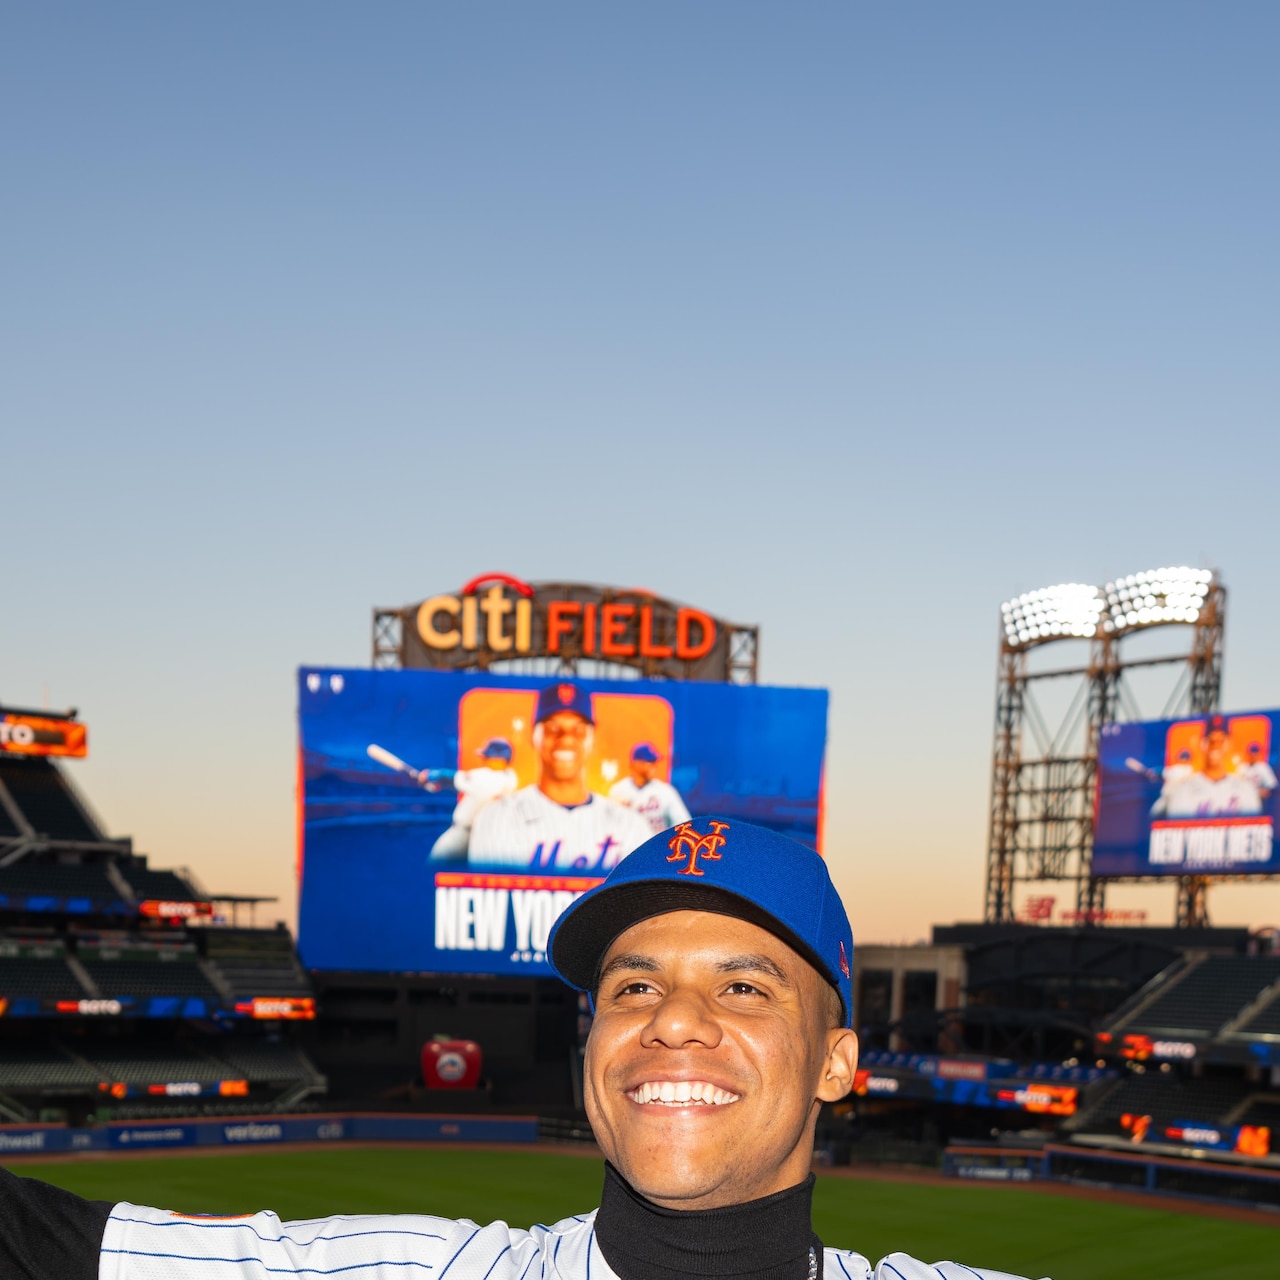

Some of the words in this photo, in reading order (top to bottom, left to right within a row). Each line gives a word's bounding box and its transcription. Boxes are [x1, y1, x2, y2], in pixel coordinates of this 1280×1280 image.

[548, 602, 716, 660] FIELD
[435, 888, 508, 950] NEW
[510, 889, 584, 950] YO
[78, 1000, 121, 1014] SOTO
[224, 1122, 282, 1141] verizon
